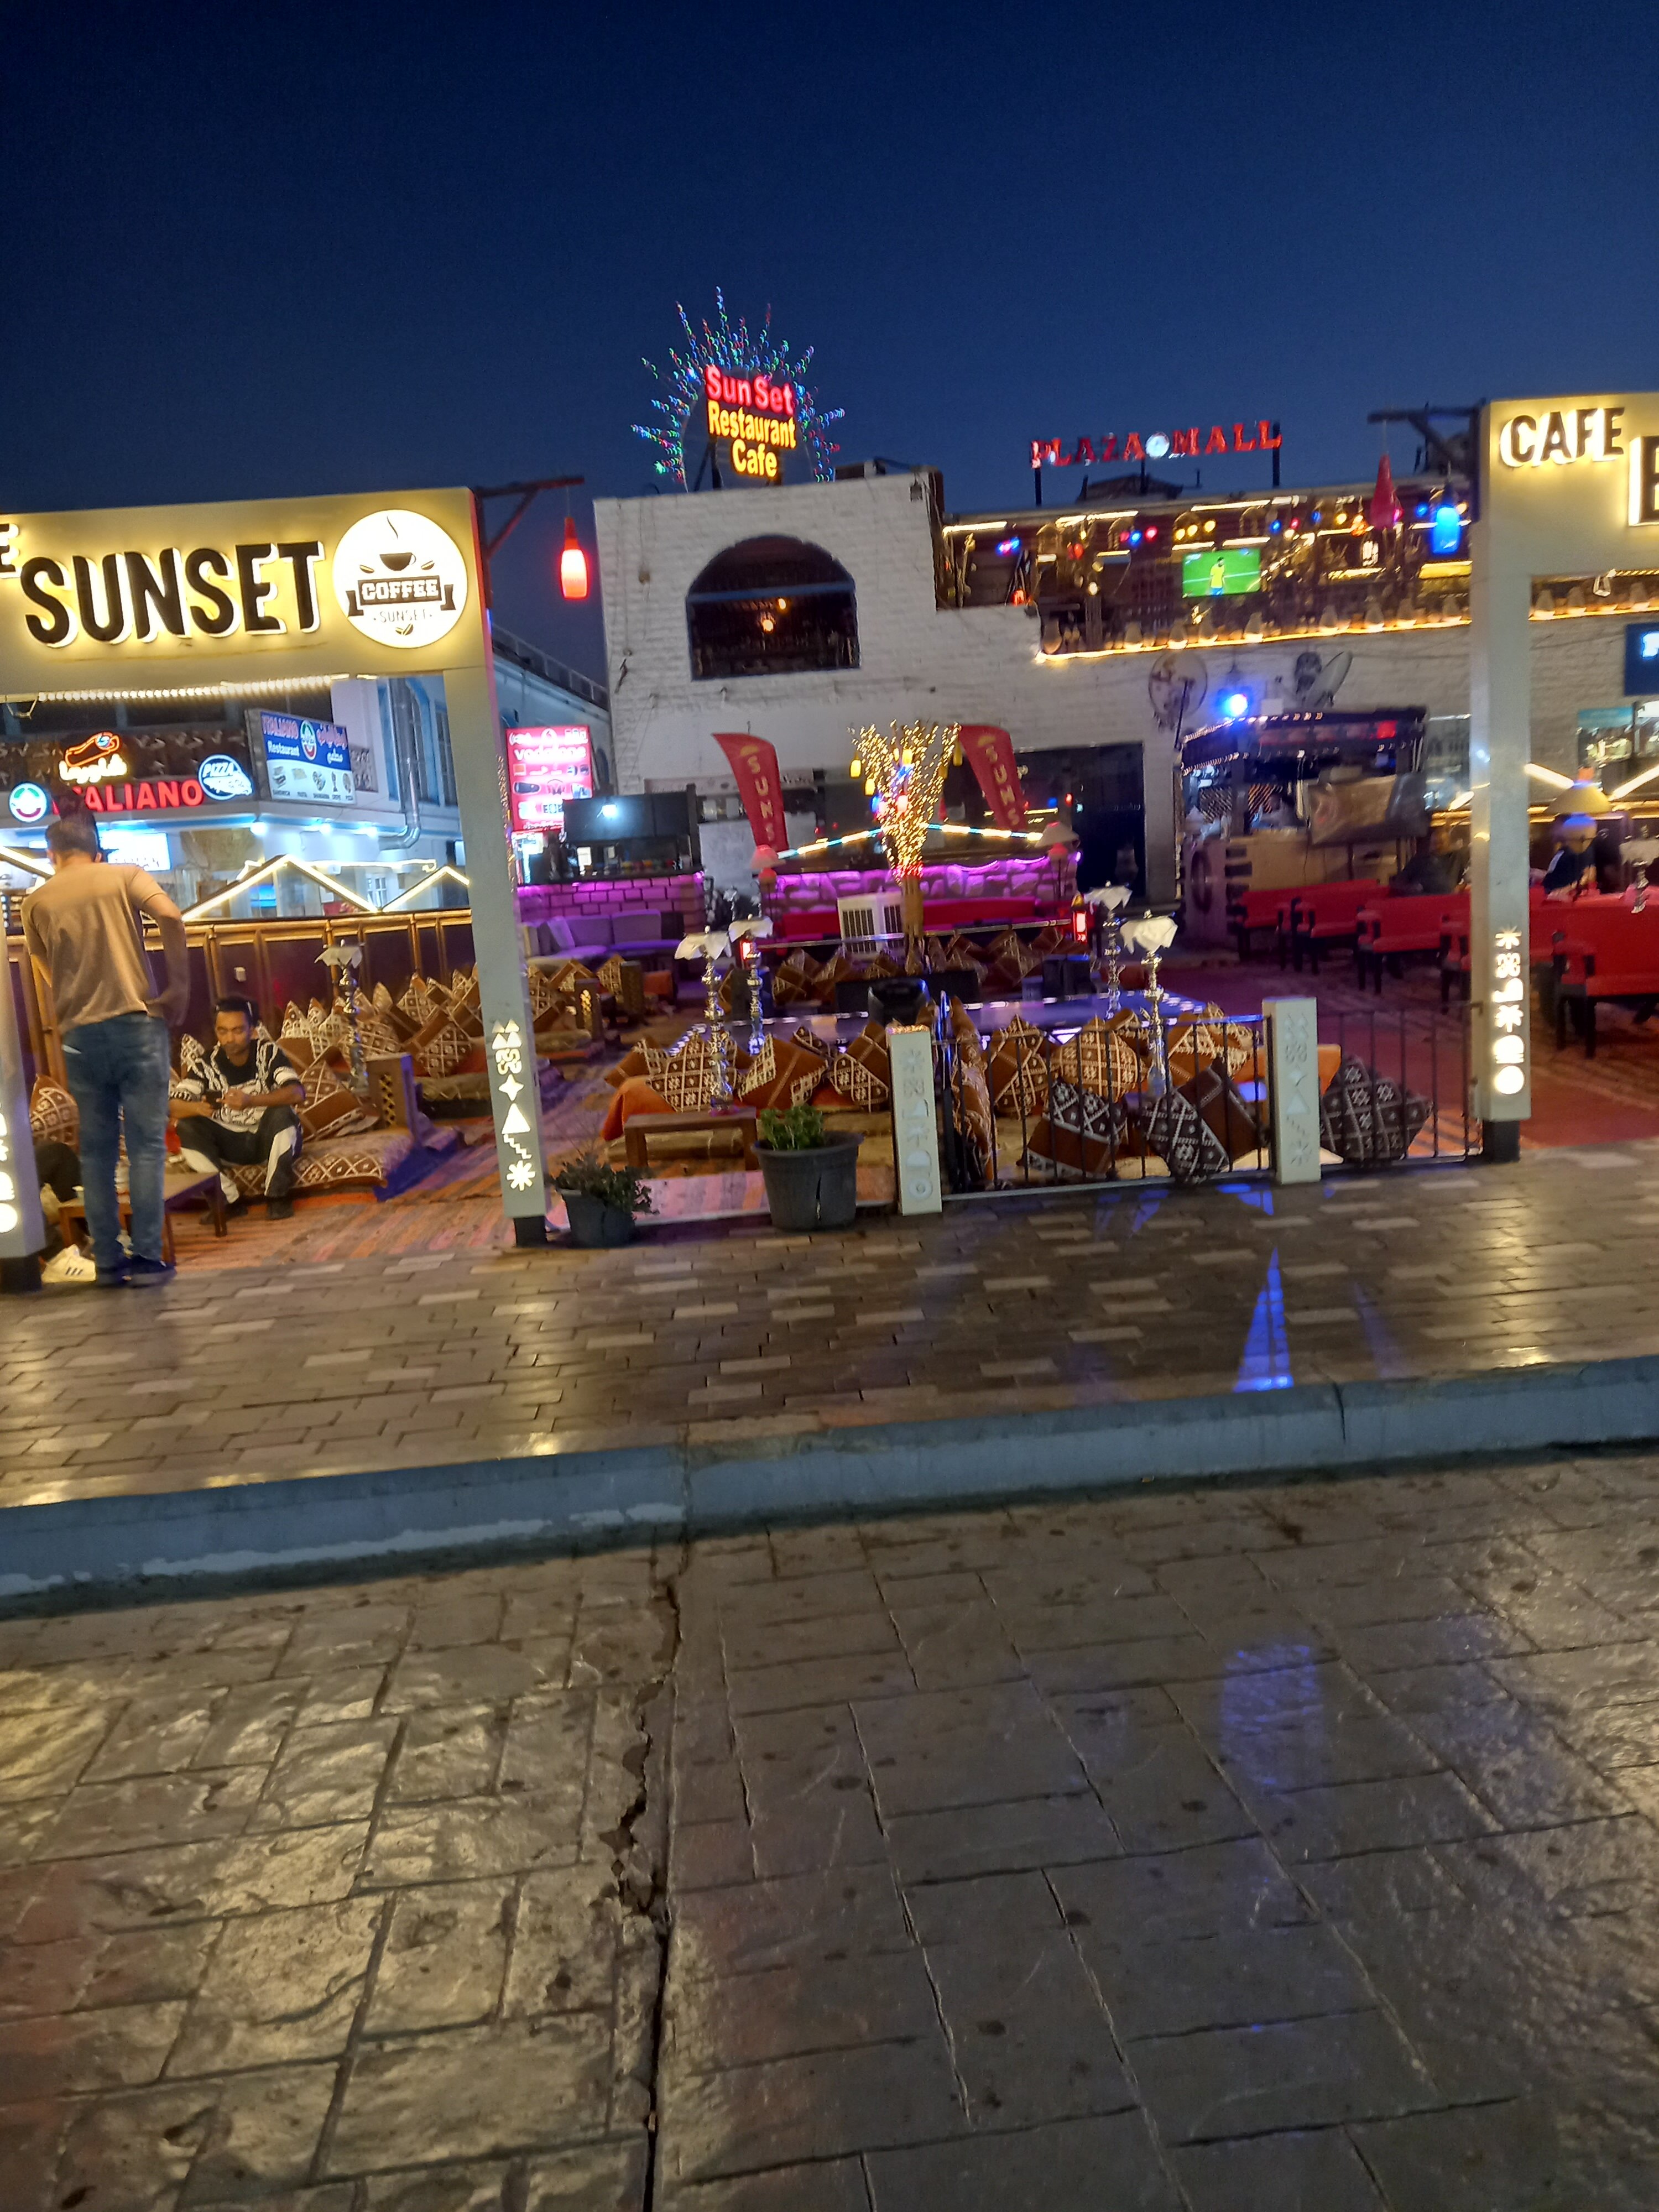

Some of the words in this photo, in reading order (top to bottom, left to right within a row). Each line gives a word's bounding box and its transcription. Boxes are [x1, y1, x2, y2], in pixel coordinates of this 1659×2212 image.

[705, 364, 752, 406] Sun
[754, 375, 794, 415] Set
[708, 400, 796, 448] Restaurant
[1501, 407, 1625, 466] CAFE
[732, 439, 777, 477] Cafe
[1031, 432, 1145, 468] PLAZA
[1172, 420, 1282, 456] MALL
[20, 540, 323, 646] SUNSET
[362, 579, 439, 600] COFFEE
[380, 609, 425, 623] SUNSET
[267, 740, 300, 757] Restaurant
[514, 746, 586, 763] vodafone
[202, 762, 234, 778] PIZZA
[51, 779, 204, 815] ALIANO
